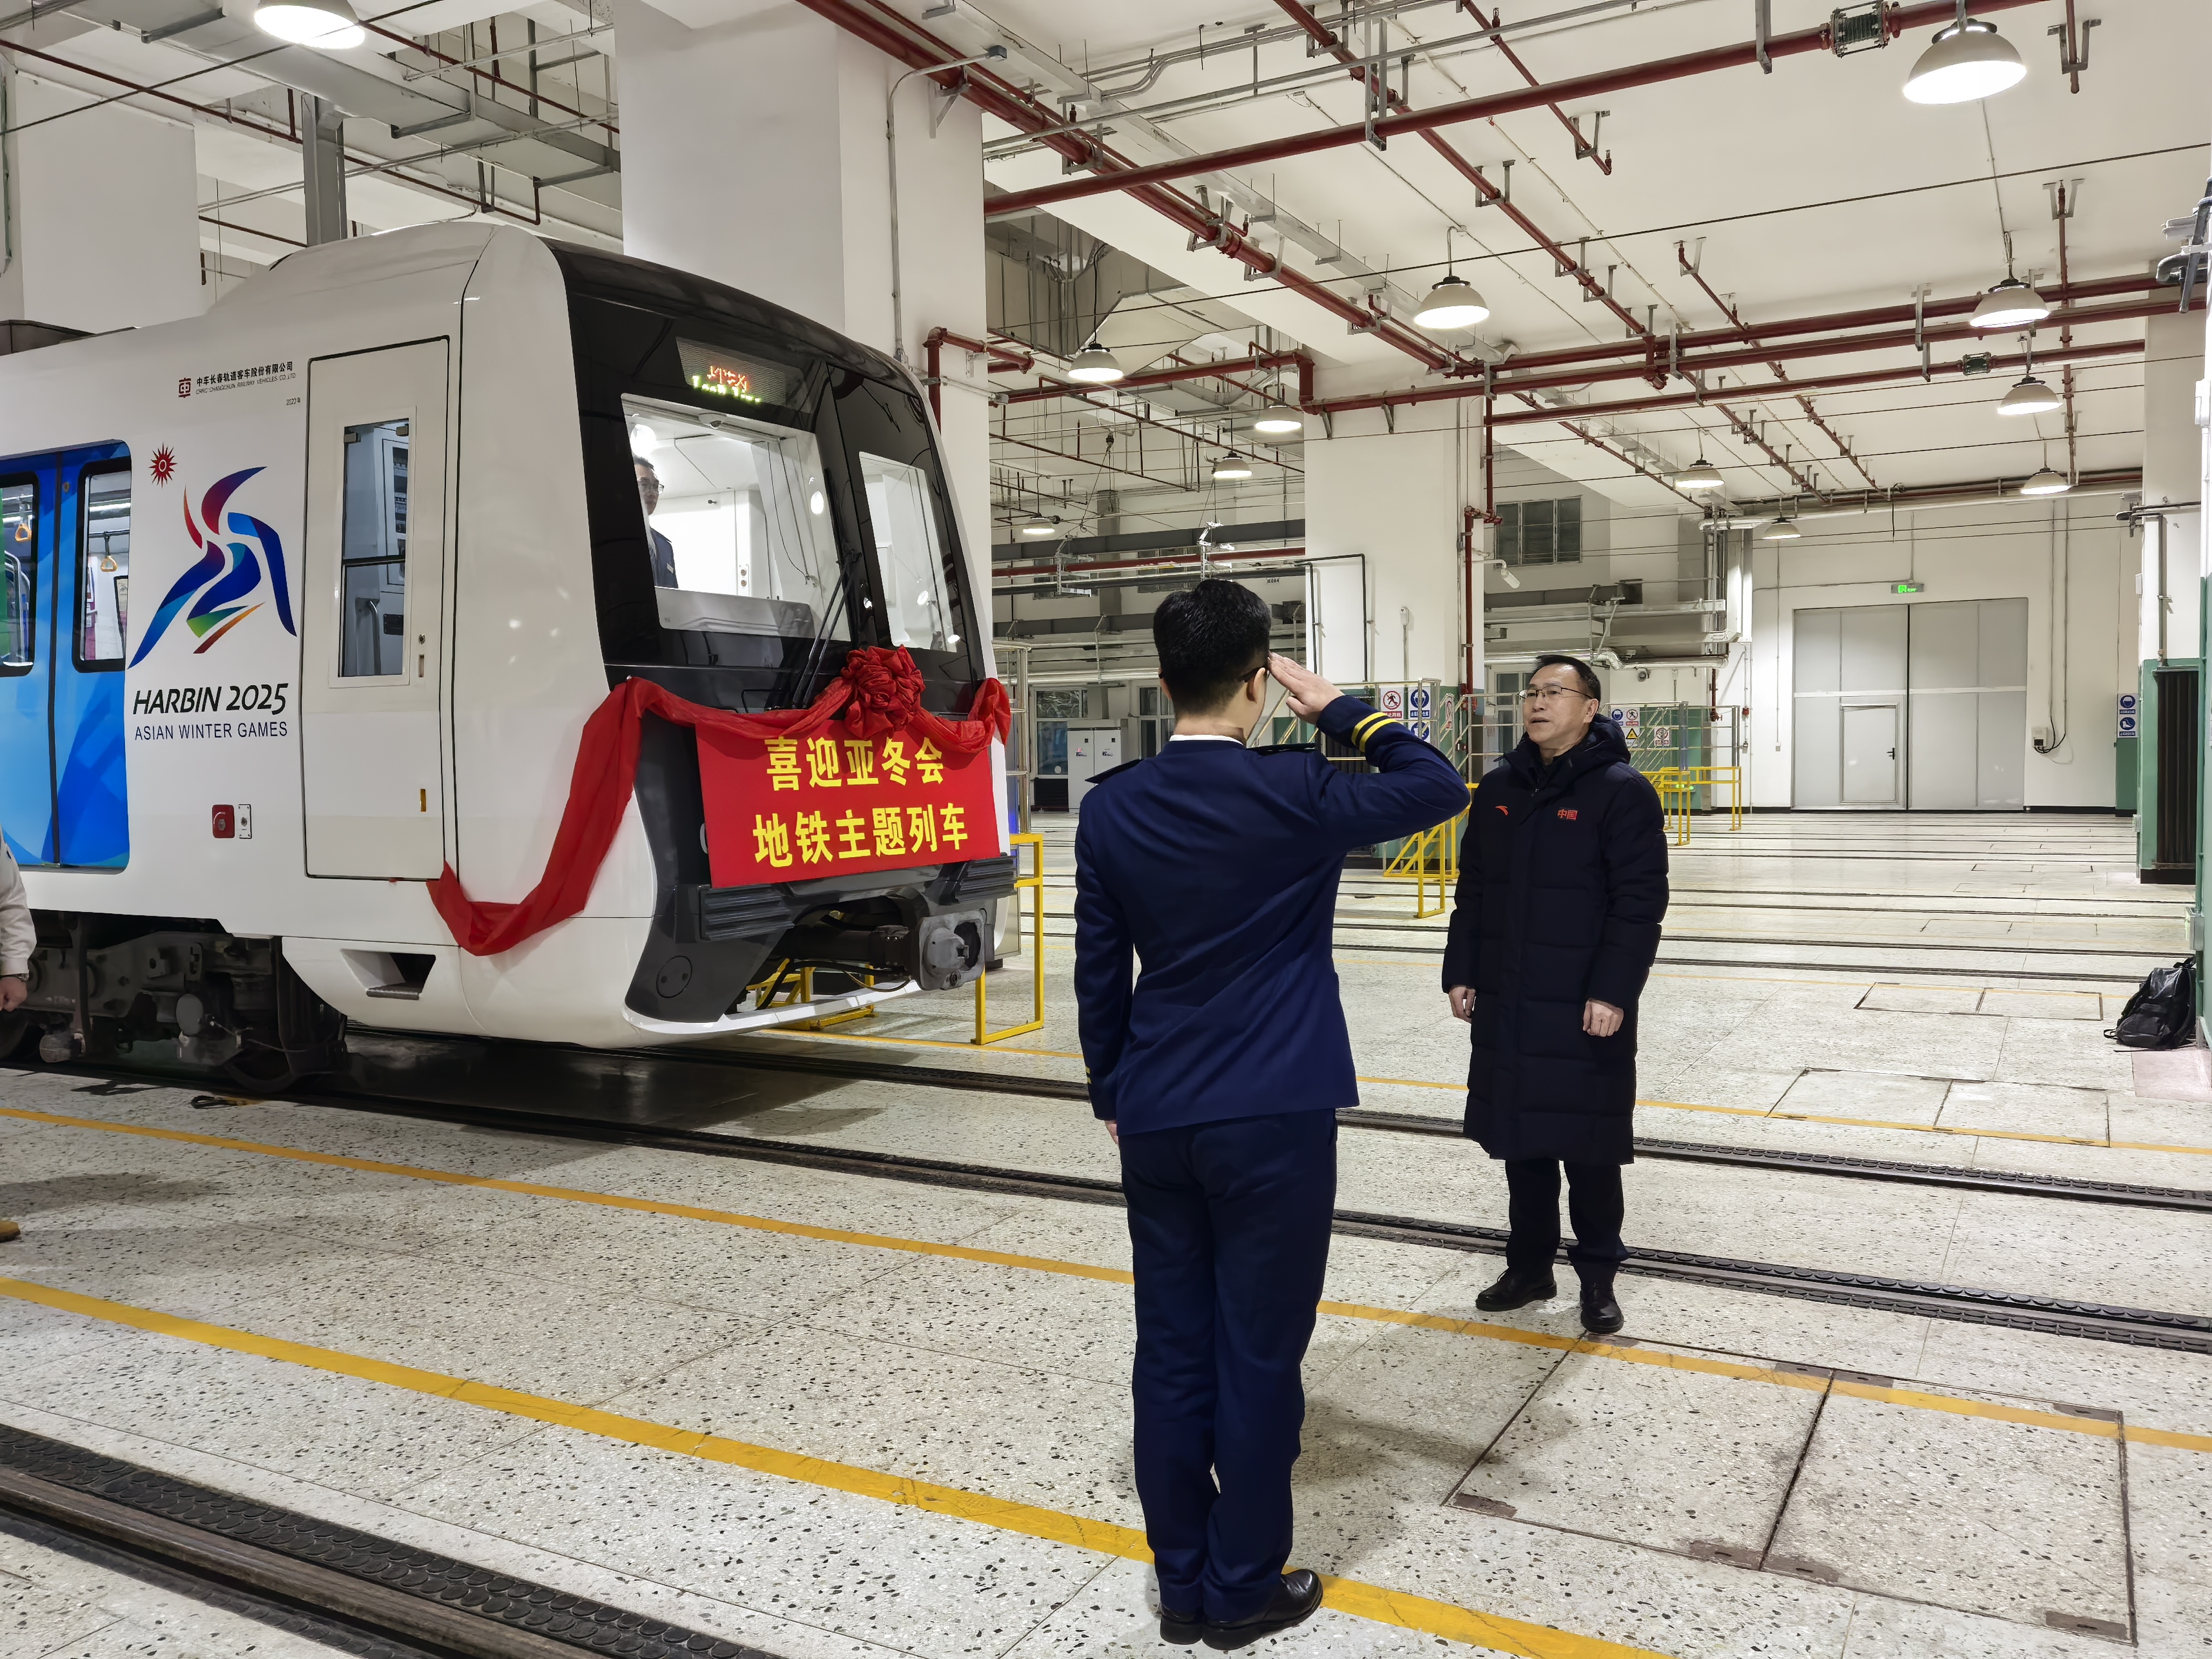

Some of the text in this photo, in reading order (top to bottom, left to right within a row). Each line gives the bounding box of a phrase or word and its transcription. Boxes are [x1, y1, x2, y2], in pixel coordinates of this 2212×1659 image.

[133, 683, 288, 715] HARBIN 2025
[135, 721, 287, 740] ASIAN WINTER GAMES
[764, 736, 944, 791] 喜迎亚冬会
[753, 802, 968, 867] 地铁主题列车
